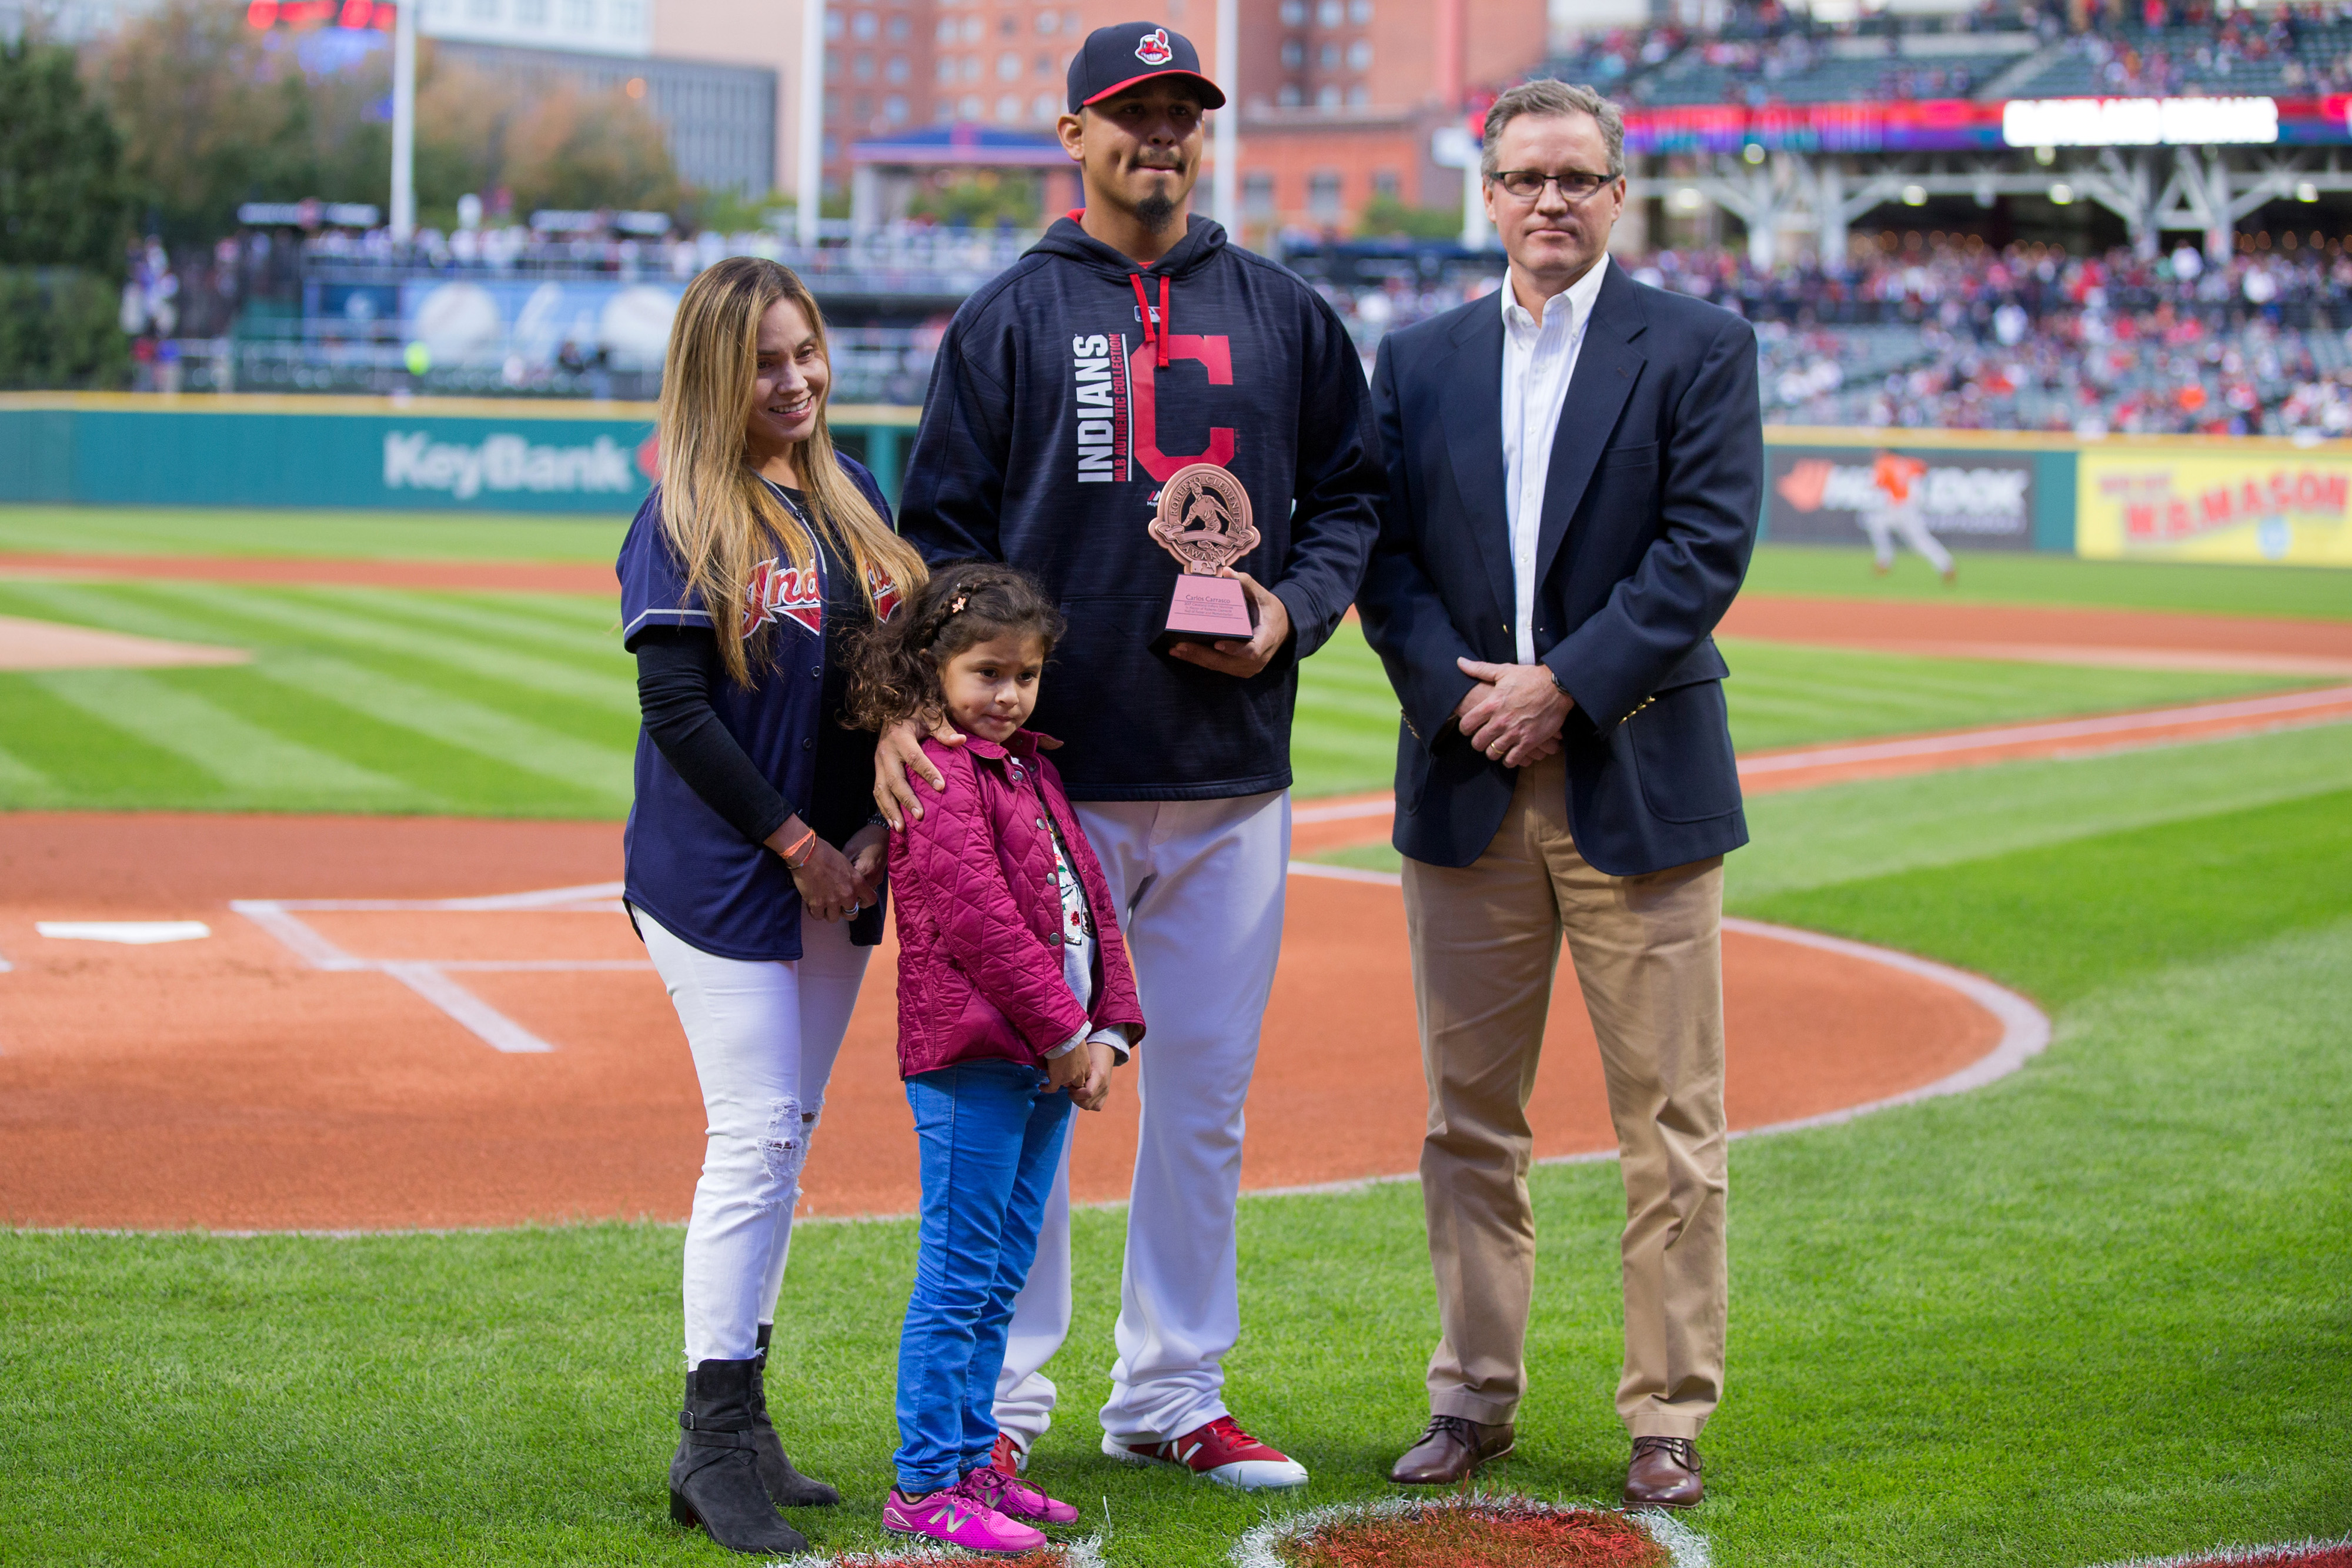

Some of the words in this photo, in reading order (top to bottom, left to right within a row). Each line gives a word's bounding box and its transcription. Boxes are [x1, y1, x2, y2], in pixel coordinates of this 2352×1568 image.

[1108, 333, 1126, 394] COLLECTION
[1073, 335, 1114, 482] INDIANS
[1114, 397, 1127, 456] AUTHENTIC
[1130, 334, 1233, 482] C
[383, 430, 632, 499] KeyBank
[1114, 459, 1127, 482] MLB
[1171, 476, 1201, 516] ROBERTO
[1205, 476, 1241, 523] CLEMENTE
[1184, 545, 1224, 560] AWARD
